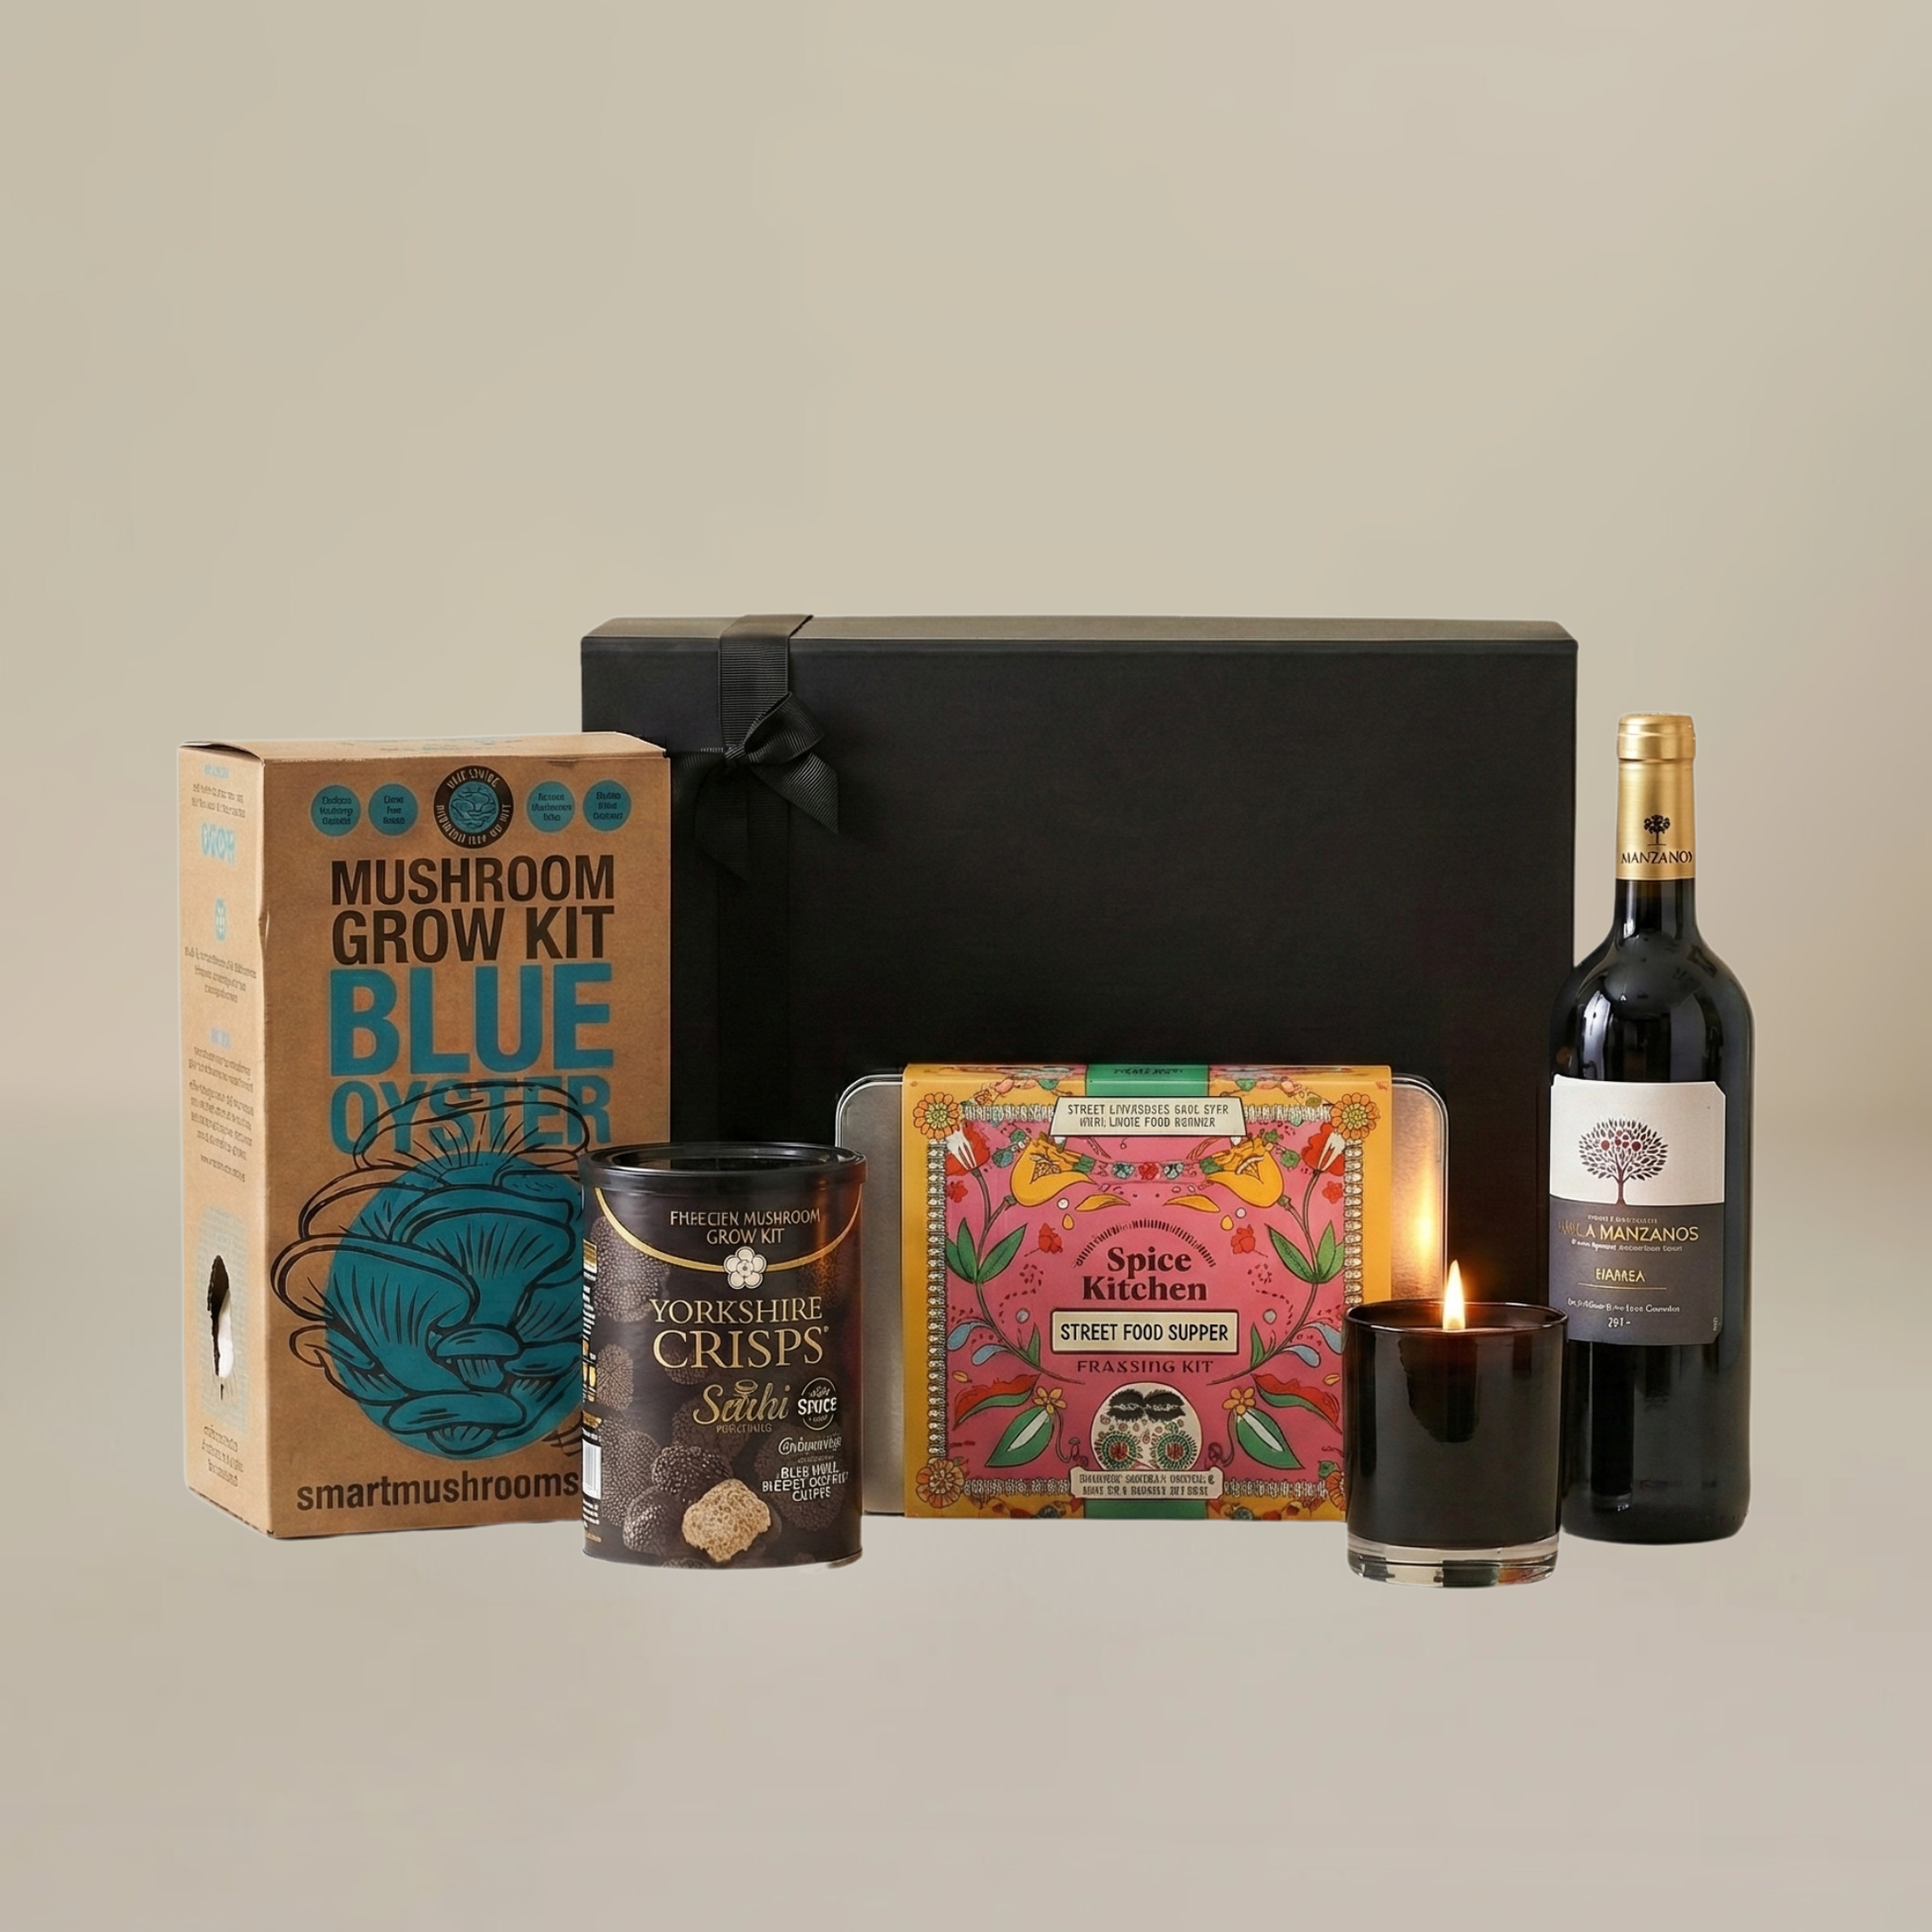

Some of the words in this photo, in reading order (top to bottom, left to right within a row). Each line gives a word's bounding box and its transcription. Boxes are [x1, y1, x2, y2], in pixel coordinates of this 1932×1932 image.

[331, 855, 616, 905] MUSHROOM
[331, 907, 505, 965] GROW
[525, 905, 615, 960] KIT
[329, 962, 614, 1077] BLUE
[330, 1074, 613, 1156] OYSTER
[1067, 1104, 1105, 1115] STREET
[1144, 1117, 1171, 1128] FOOD
[745, 1208, 821, 1226] MUSHROOM
[707, 1228, 758, 1244] GROW
[760, 1227, 785, 1244] KIT
[1599, 1224, 1700, 1242] MANZANOS
[1107, 1246, 1192, 1280] Spice
[1082, 1275, 1207, 1301] Kitchen
[649, 1296, 823, 1323] YORKSHIRE
[1060, 1323, 1119, 1341] STREET
[1123, 1323, 1164, 1341] FOOD
[1168, 1323, 1229, 1341] SUPPER
[652, 1325, 824, 1369] CRISPS
[1182, 1360, 1214, 1373] KIT
[297, 1470, 580, 1511] smartmushrooms
